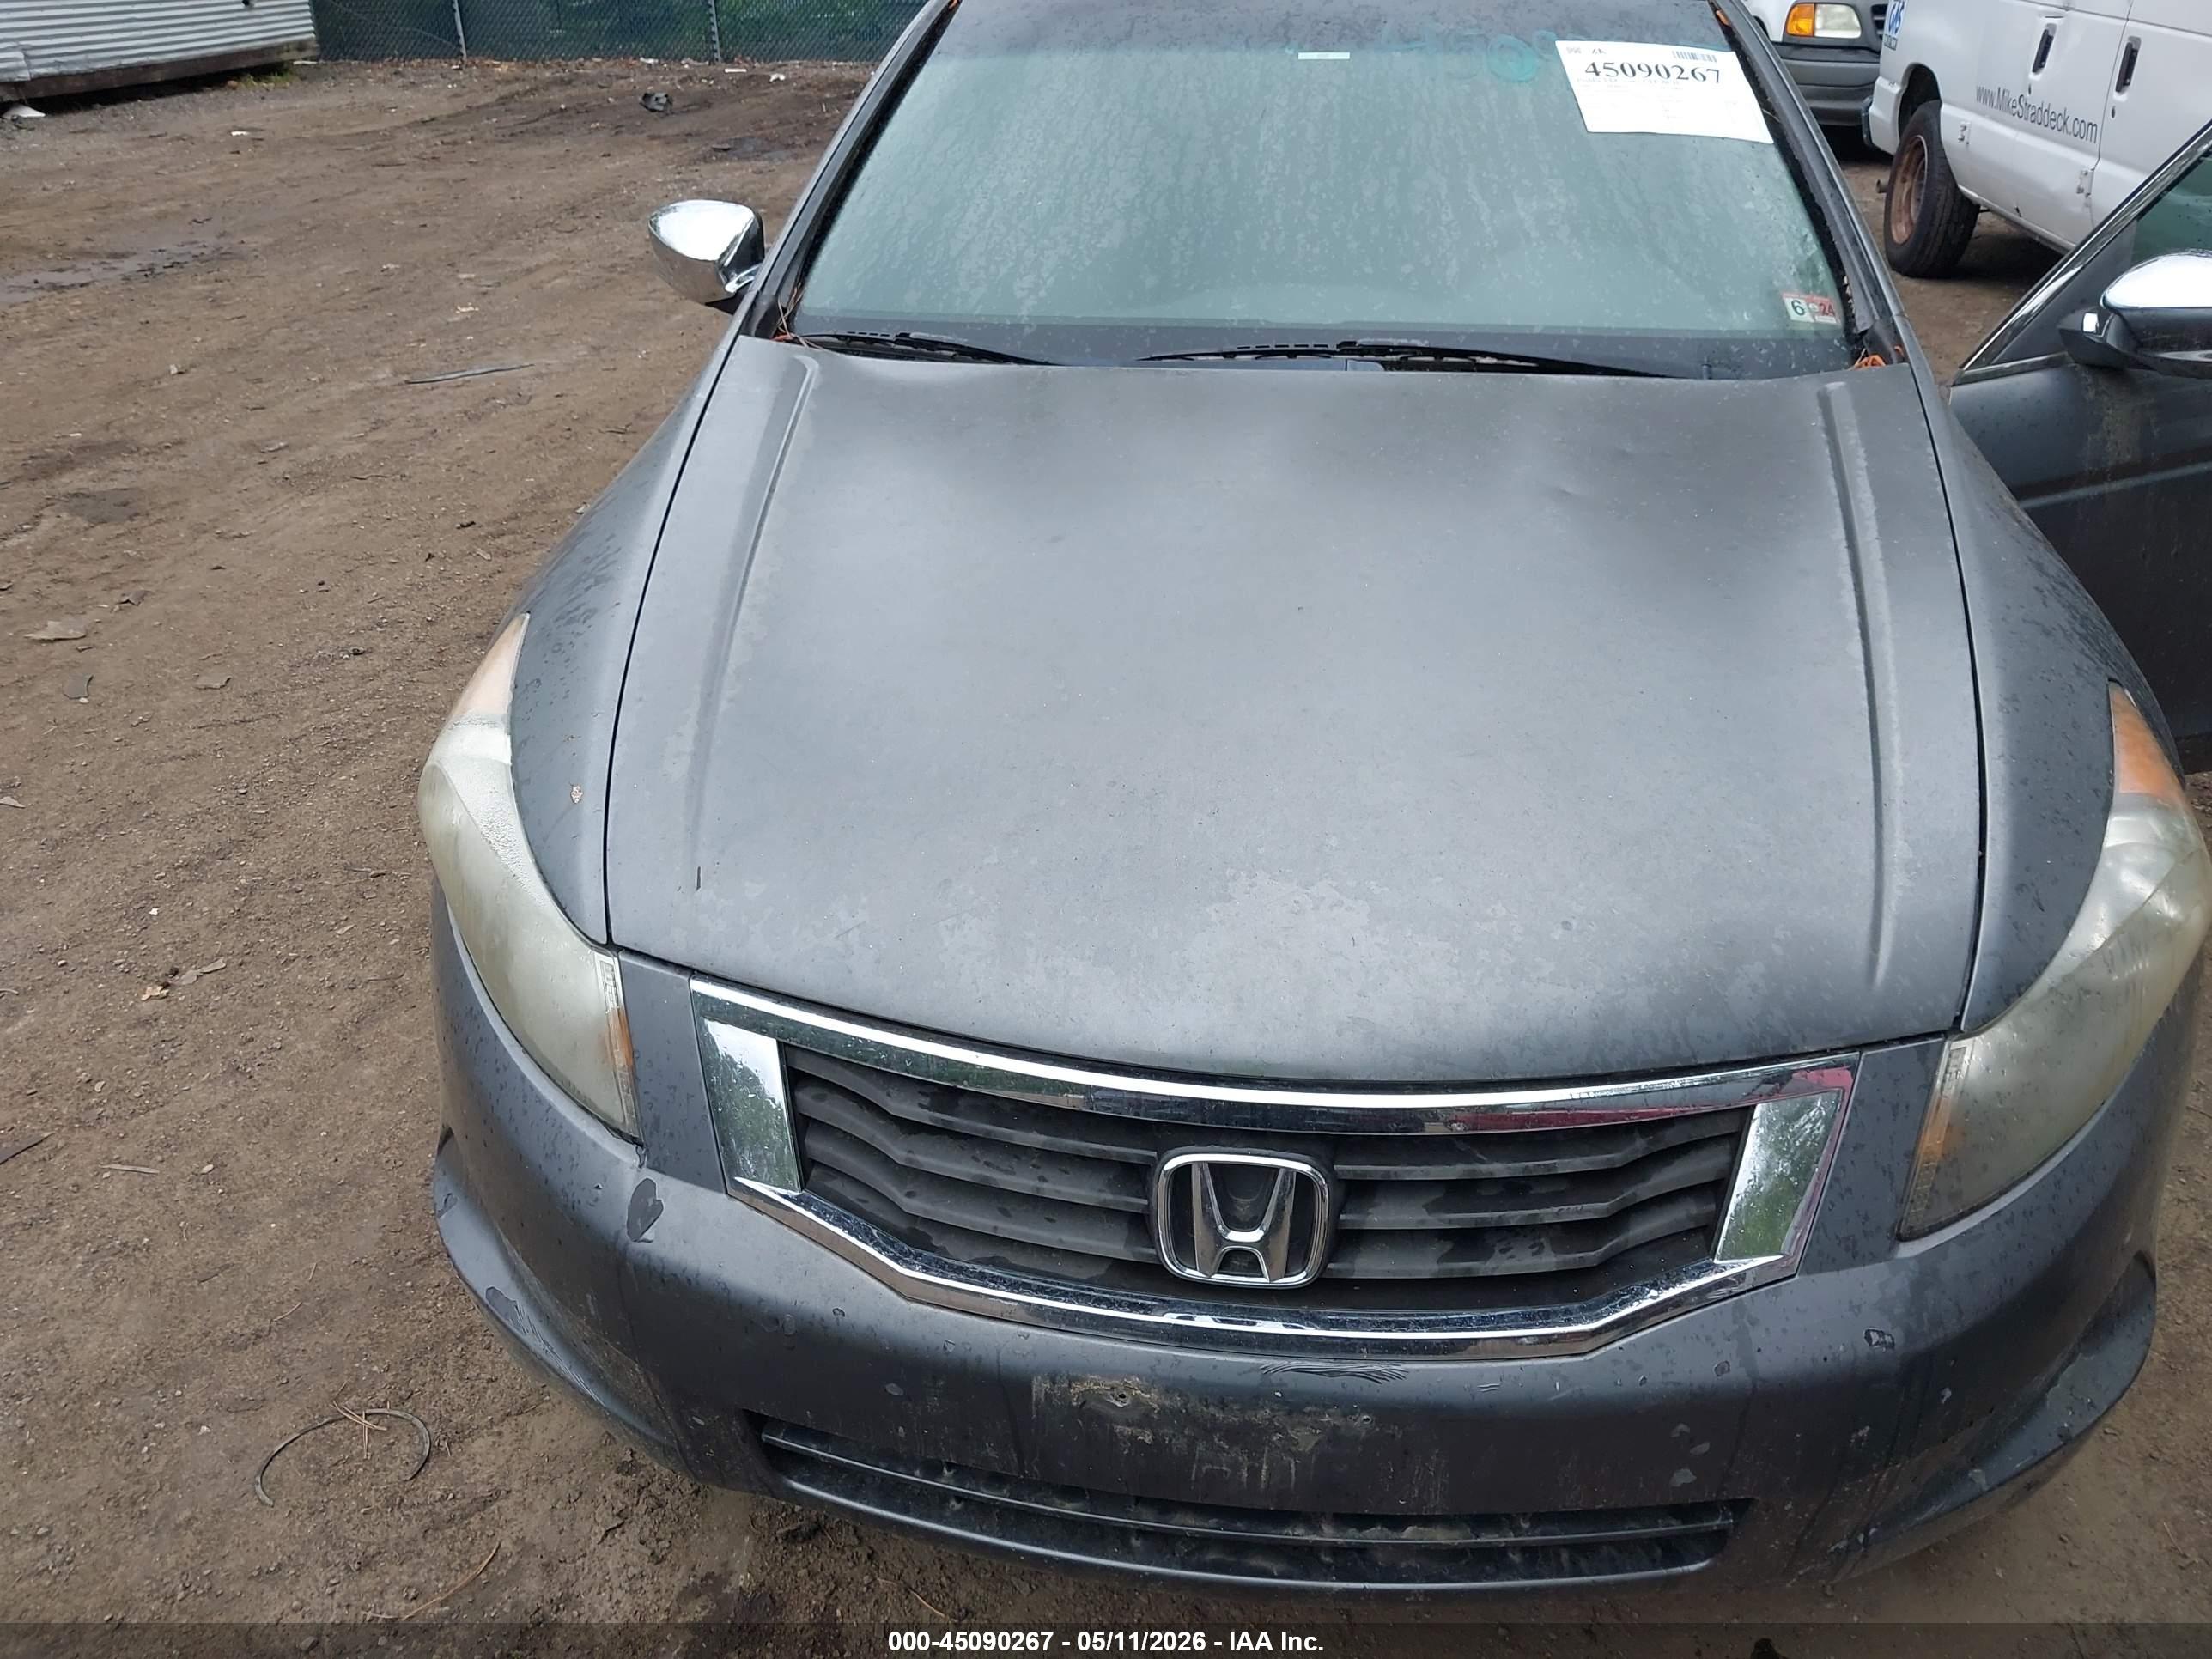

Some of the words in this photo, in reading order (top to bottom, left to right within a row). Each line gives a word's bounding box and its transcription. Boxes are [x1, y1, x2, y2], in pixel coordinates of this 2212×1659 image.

[1584, 61, 1720, 83] 45090267
[1976, 85, 2098, 144] www.MikeStraddeck.com
[1791, 299, 1806, 317] 6
